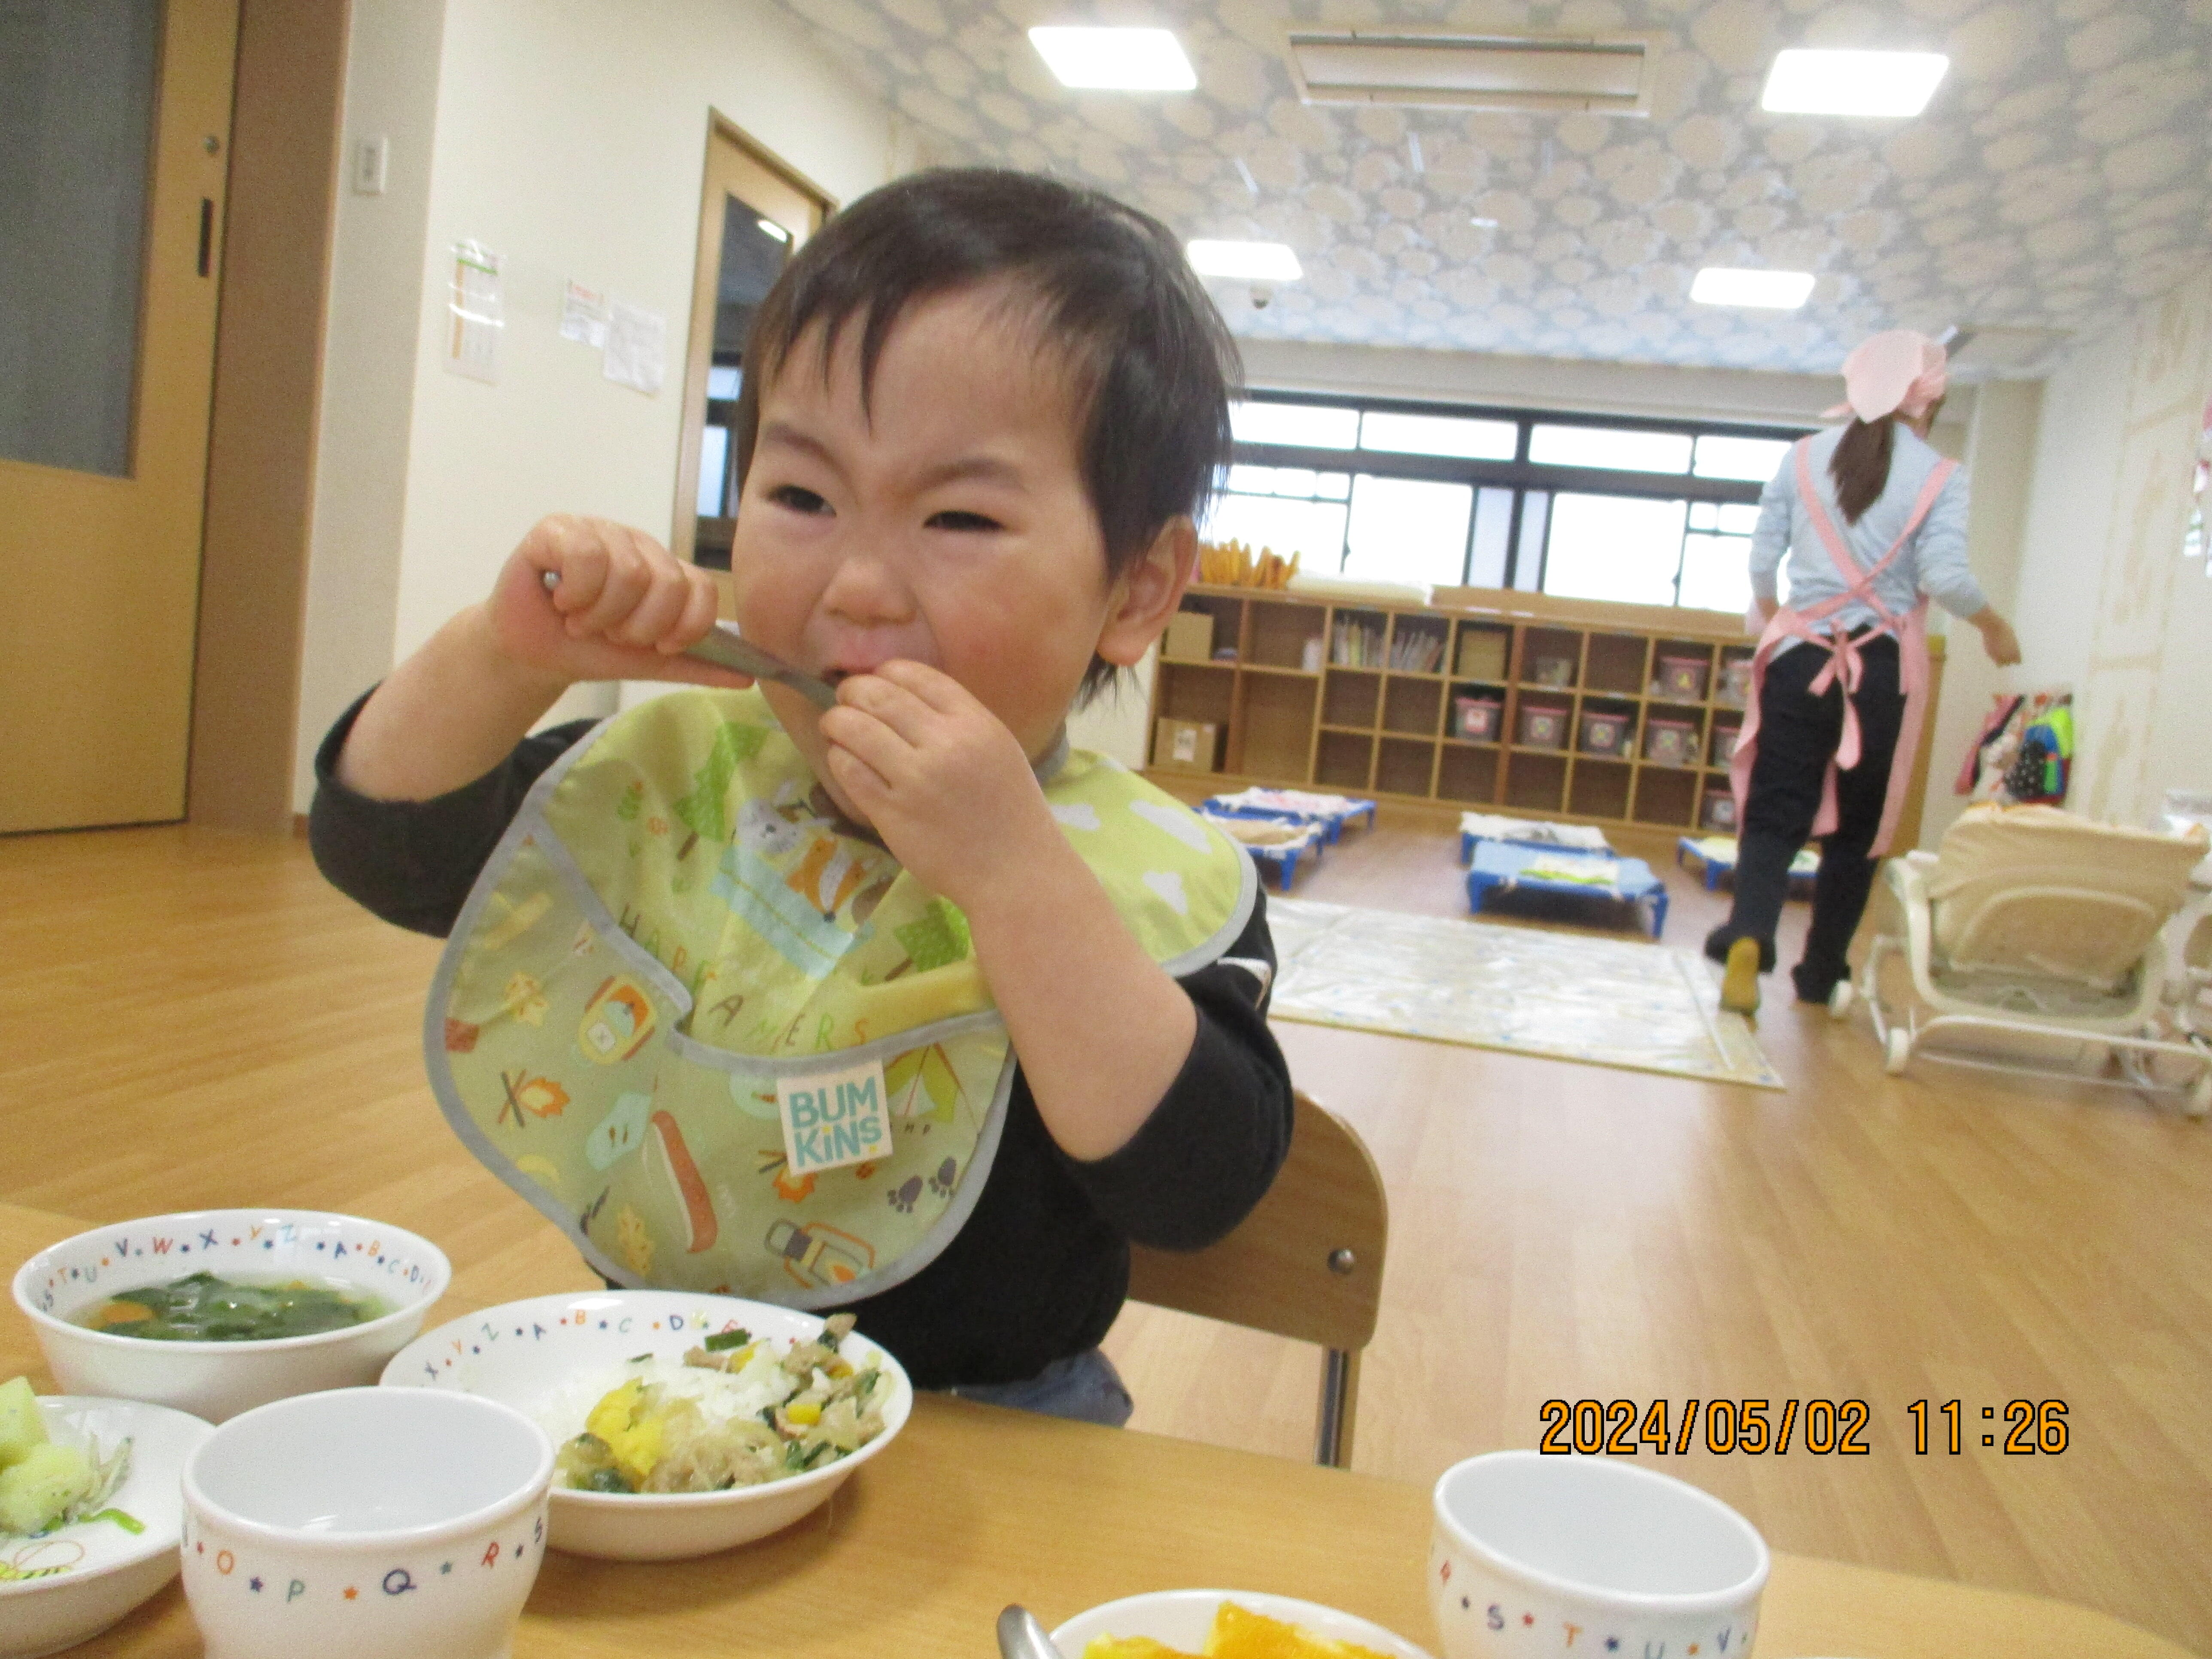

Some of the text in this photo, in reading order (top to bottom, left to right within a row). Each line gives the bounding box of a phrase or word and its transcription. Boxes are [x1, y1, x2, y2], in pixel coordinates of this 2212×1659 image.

[788, 1076, 878, 1129] BUM
[115, 1238, 129, 1257] V
[152, 1236, 173, 1254] W
[199, 1228, 219, 1250] X
[250, 1225, 264, 1240] Y
[281, 1224, 297, 1242] Z
[334, 1241, 347, 1260] A
[424, 1360, 439, 1381] X
[481, 1322, 499, 1341] Z
[533, 1322, 547, 1340] A
[575, 1309, 586, 1325] B
[619, 1317, 633, 1333] C
[669, 1314, 684, 1331] D
[216, 1549, 234, 1575] O
[287, 1579, 306, 1603] P
[383, 1568, 417, 1596] Q
[481, 1540, 500, 1569] R
[1487, 1602, 1505, 1631] S
[1563, 1620, 1584, 1648] T
[1644, 1641, 1666, 1659] U
